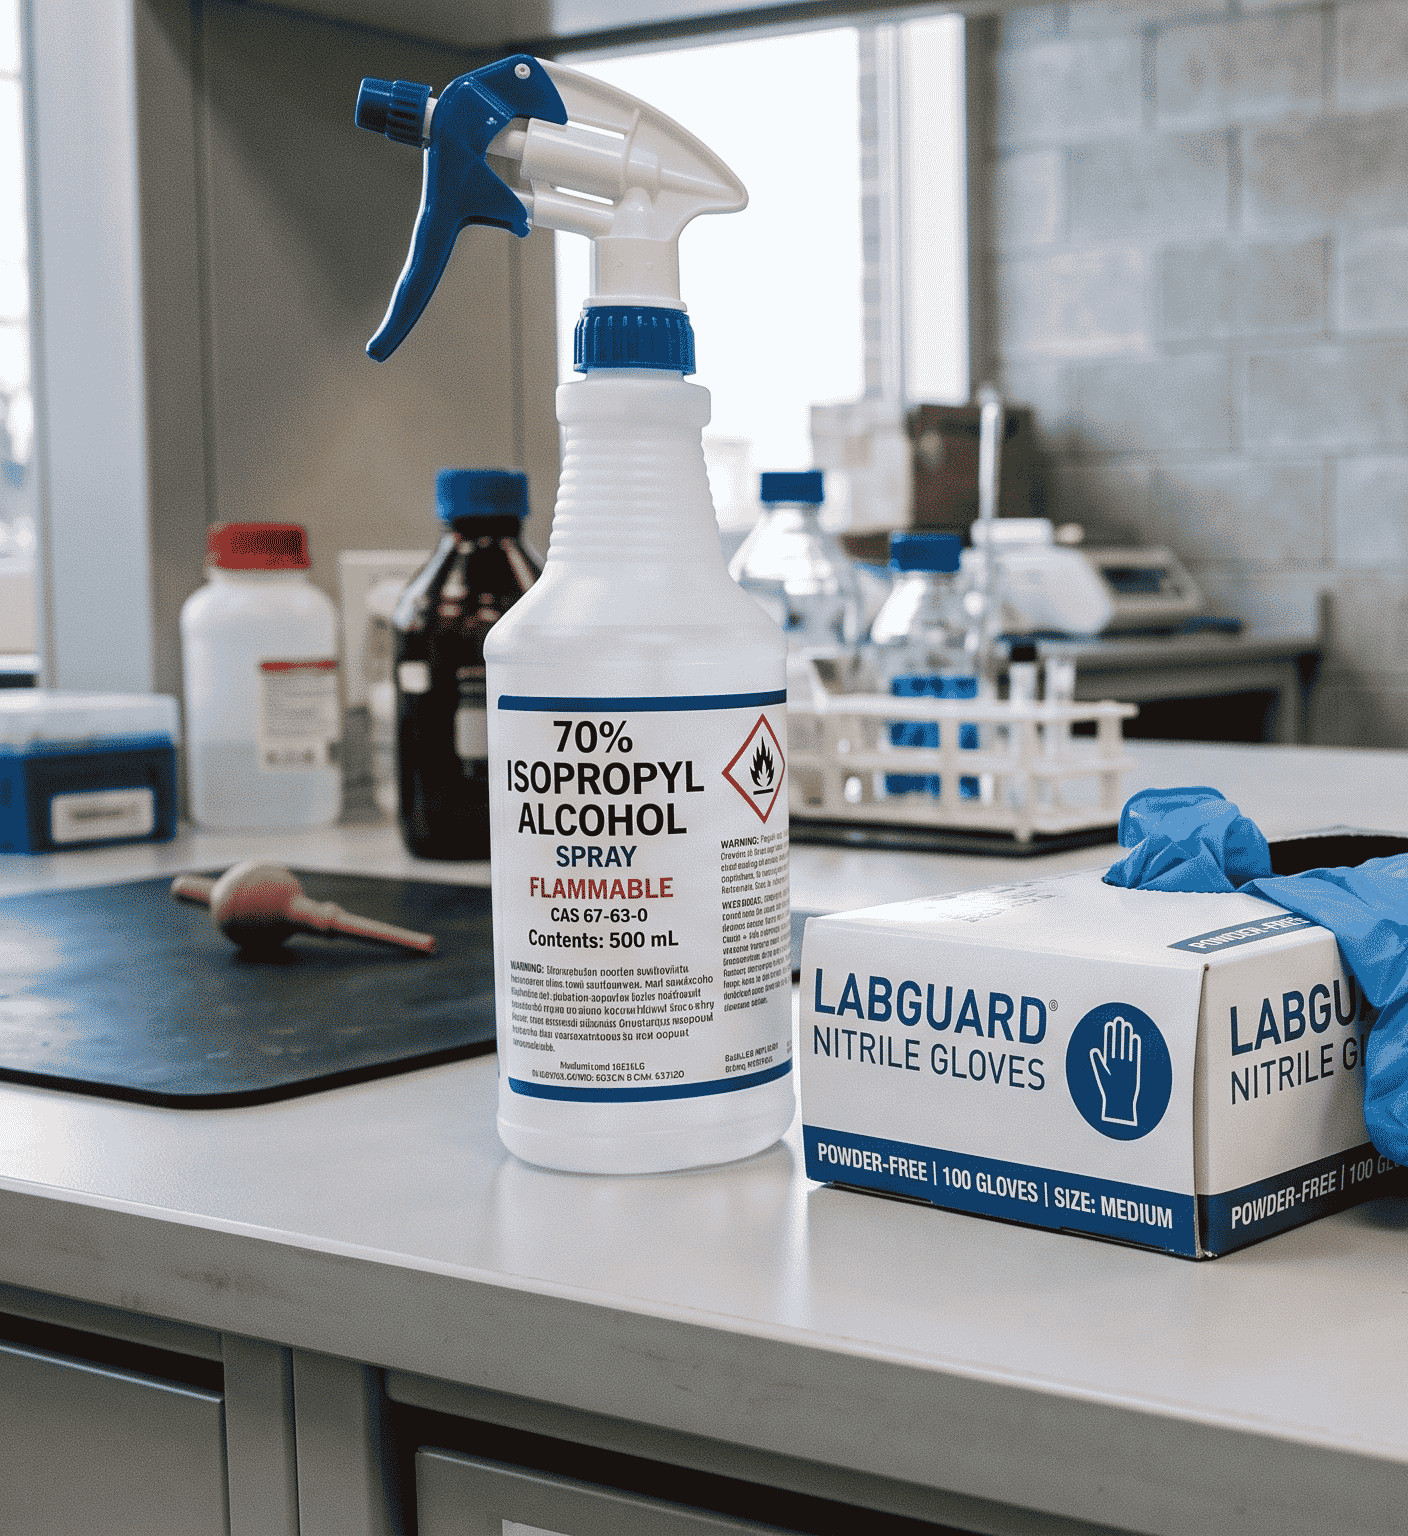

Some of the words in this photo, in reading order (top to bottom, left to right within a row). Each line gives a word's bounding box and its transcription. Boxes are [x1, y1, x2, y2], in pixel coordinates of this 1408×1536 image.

[554, 721, 633, 753] 70%
[508, 760, 705, 795] ISOPROPYL
[518, 803, 687, 836] ALCOHOL
[556, 845, 637, 868] SPRAY
[529, 877, 674, 900] FLAMMABLE
[550, 908, 580, 923] CAS
[583, 907, 648, 923] 67-63-0
[528, 929, 604, 949] Contents:
[609, 931, 646, 949] 500
[651, 930, 679, 948] mL
[813, 1025, 920, 1072] NITRILE
[931, 1042, 1045, 1091] GLOVES
[1231, 1042, 1334, 1105] NITRILE
[818, 1142, 928, 1182] POWDER-FREE
[942, 1165, 972, 1190] 100
[976, 1172, 1039, 1204] GLOVES
[1054, 1186, 1096, 1214] SIZE:
[1101, 1194, 1173, 1229] MEDIUM
[1231, 1171, 1337, 1229] POWDER-FREE
[1349, 1158, 1373, 1183] 100
